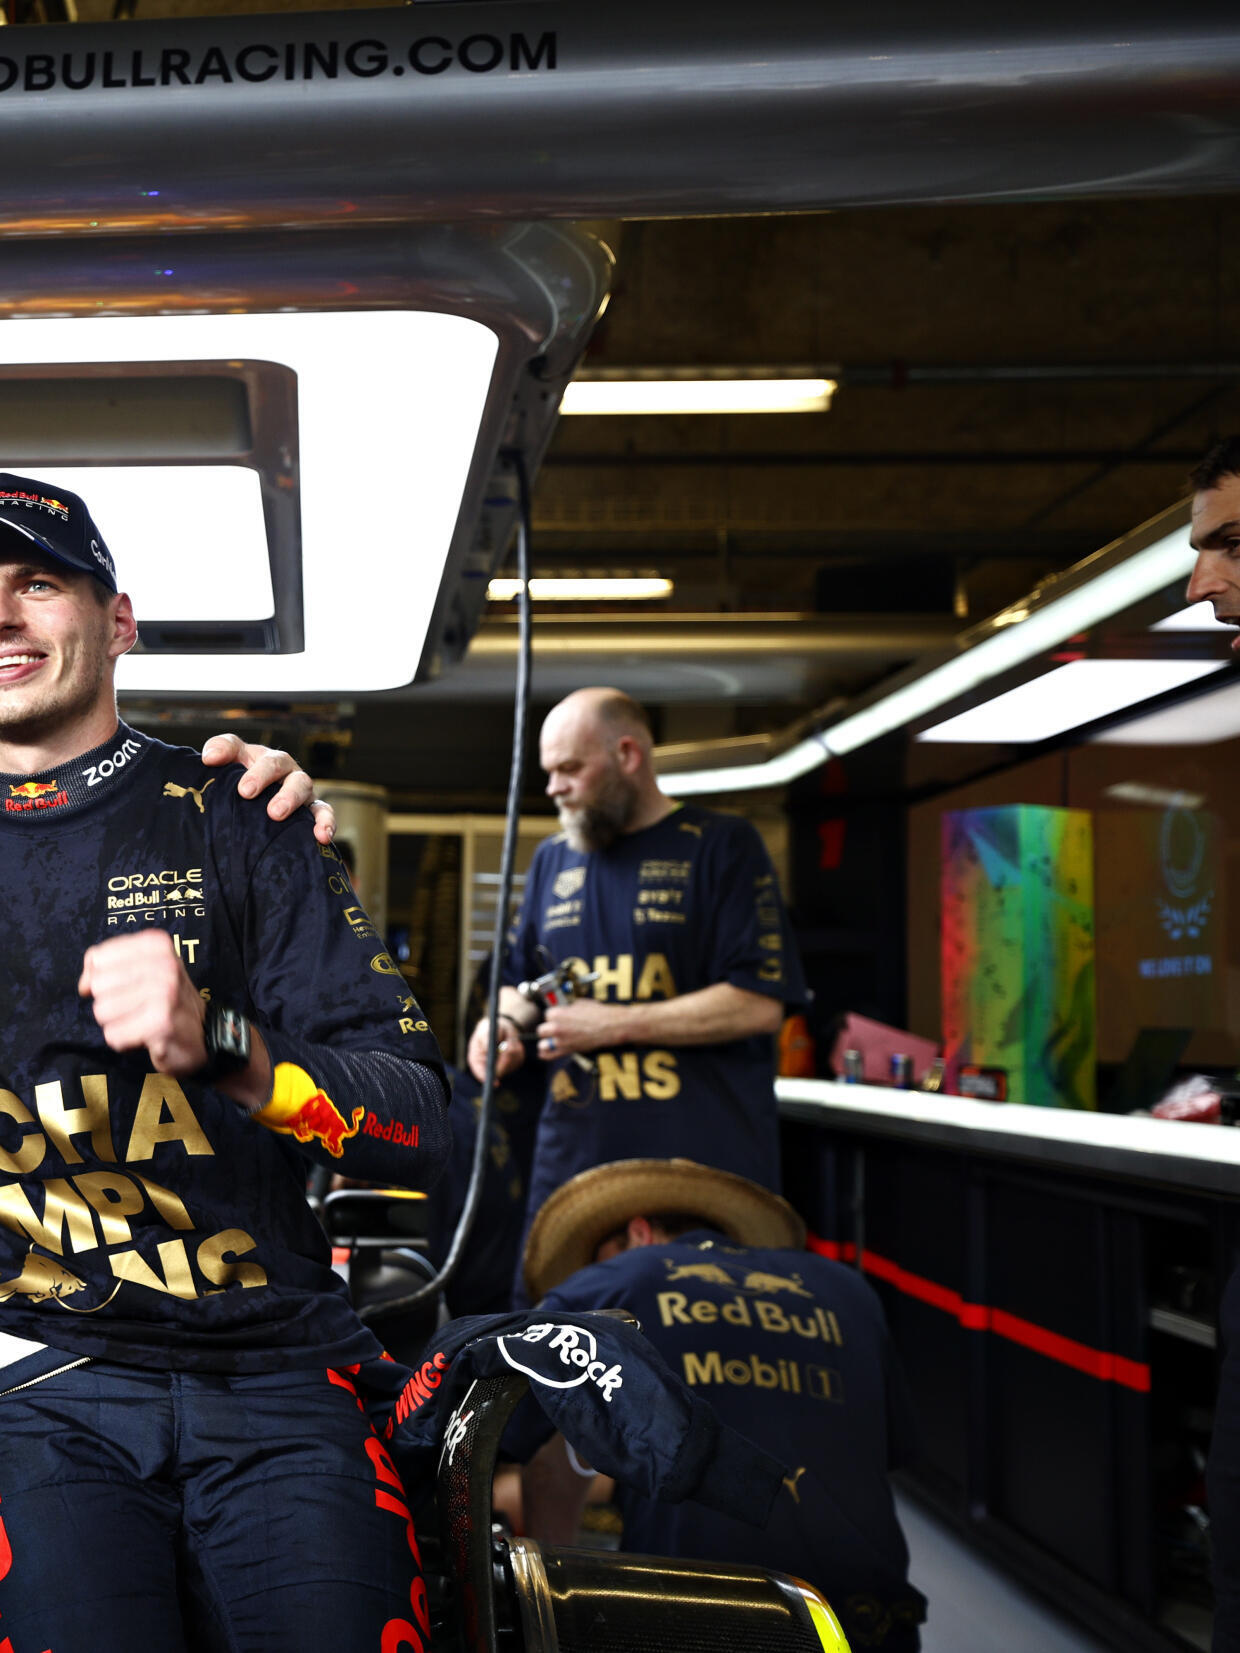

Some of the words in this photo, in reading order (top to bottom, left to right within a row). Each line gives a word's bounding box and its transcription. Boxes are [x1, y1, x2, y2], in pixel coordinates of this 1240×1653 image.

[108, 868, 204, 892] ORACLE
[107, 907, 206, 925] RACING
[398, 1017, 429, 1034] Re
[596, 1051, 681, 1101] NS
[108, 1227, 268, 1300] NS
[656, 1291, 752, 1329] Red
[754, 1300, 845, 1347] Bull
[681, 1352, 802, 1394] Mobil
